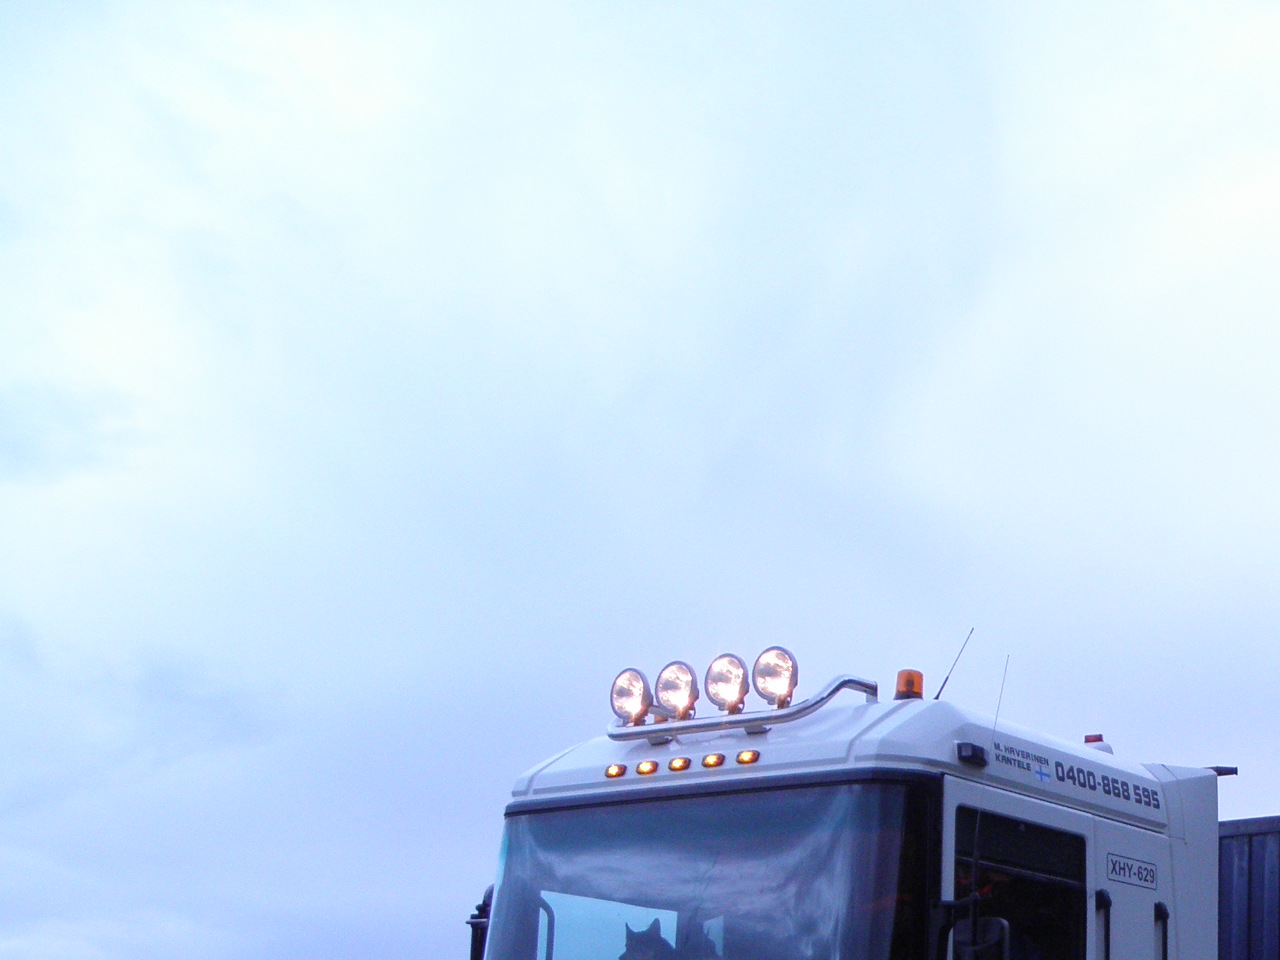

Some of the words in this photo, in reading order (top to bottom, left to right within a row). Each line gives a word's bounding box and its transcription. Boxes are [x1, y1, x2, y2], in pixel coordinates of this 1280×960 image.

[994, 752, 1031, 771] KANTELE
[1055, 760, 1131, 800] 0400-868
[1133, 783, 1160, 809] 595
[1110, 858, 1155, 884] XHY-629
